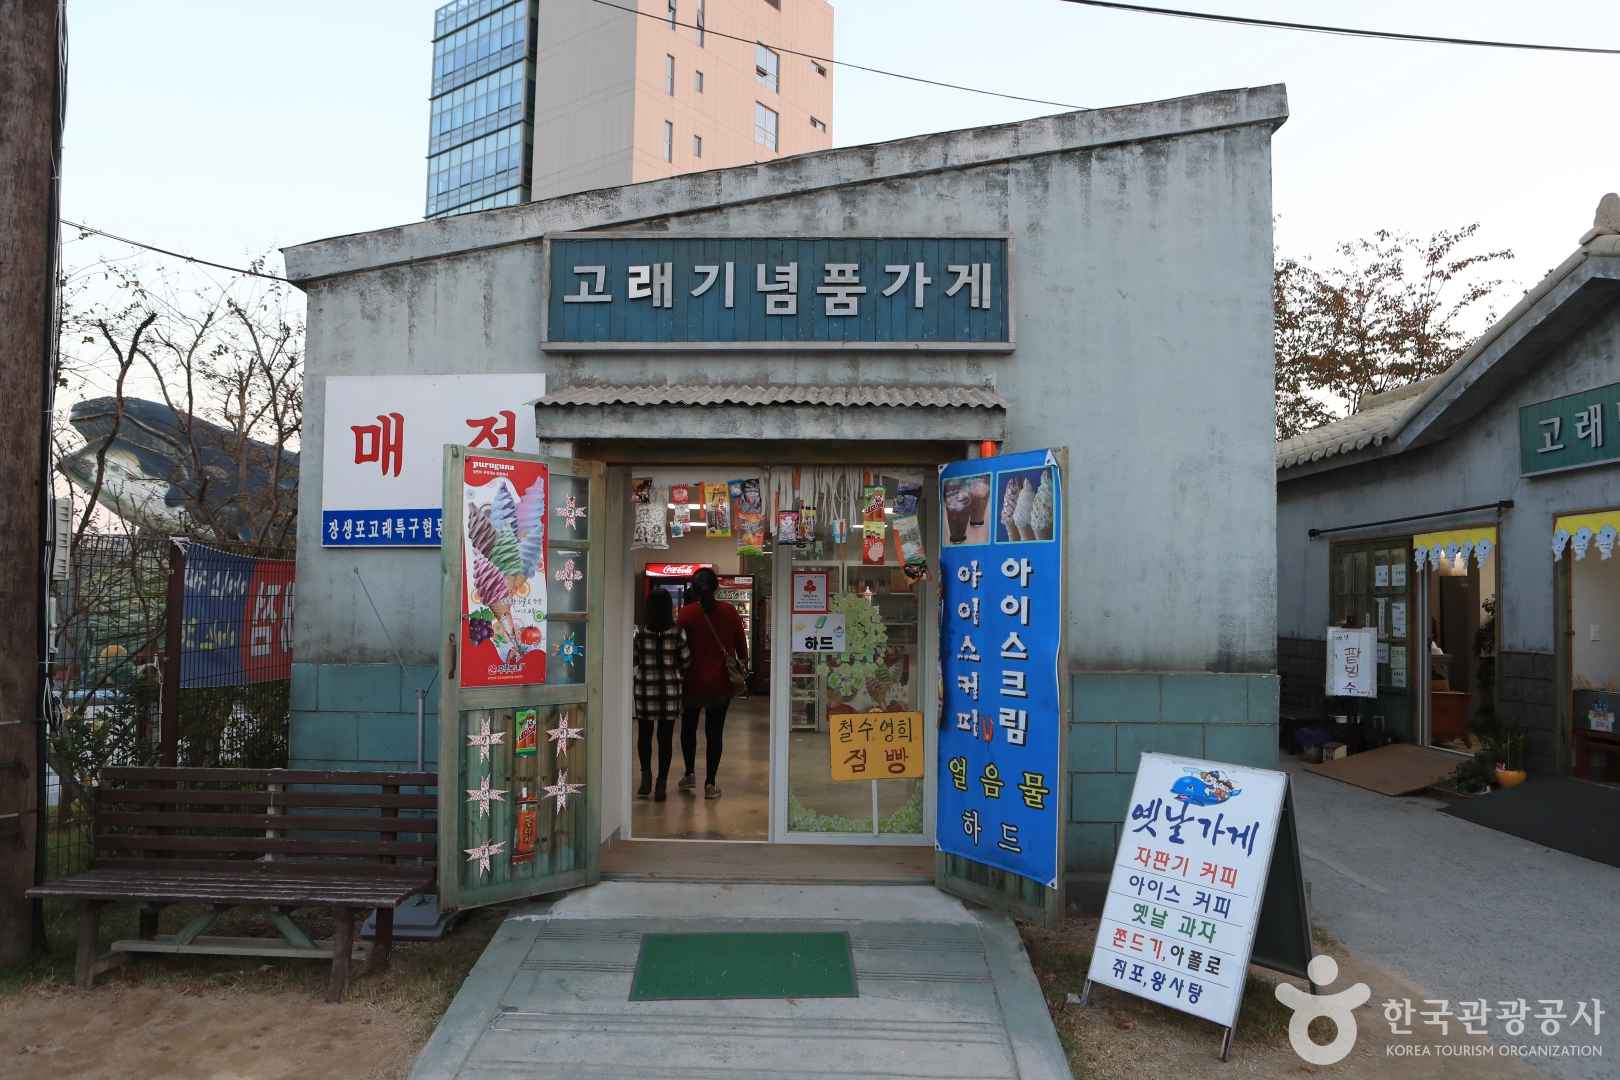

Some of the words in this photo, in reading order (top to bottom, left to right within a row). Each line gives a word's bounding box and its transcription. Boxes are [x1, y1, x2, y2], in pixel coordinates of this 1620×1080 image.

[563, 261, 992, 316] 고래기념품가게
[1536, 402, 1620, 453] 고래
[804, 635, 834, 650] 하드
[999, 557, 1034, 745] 아이스크림
[843, 746, 909, 774] 점빵
[949, 757, 1050, 809] 얼음물
[962, 810, 1021, 852] 하드
[1131, 798, 1259, 856] 옛날가게
[1134, 846, 1190, 877] 자판기
[1199, 861, 1239, 889] 커피
[1129, 875, 1181, 904] 아이스
[1193, 890, 1232, 919] 커피
[1132, 903, 1169, 929] 옛날
[1178, 915, 1216, 944] 과자
